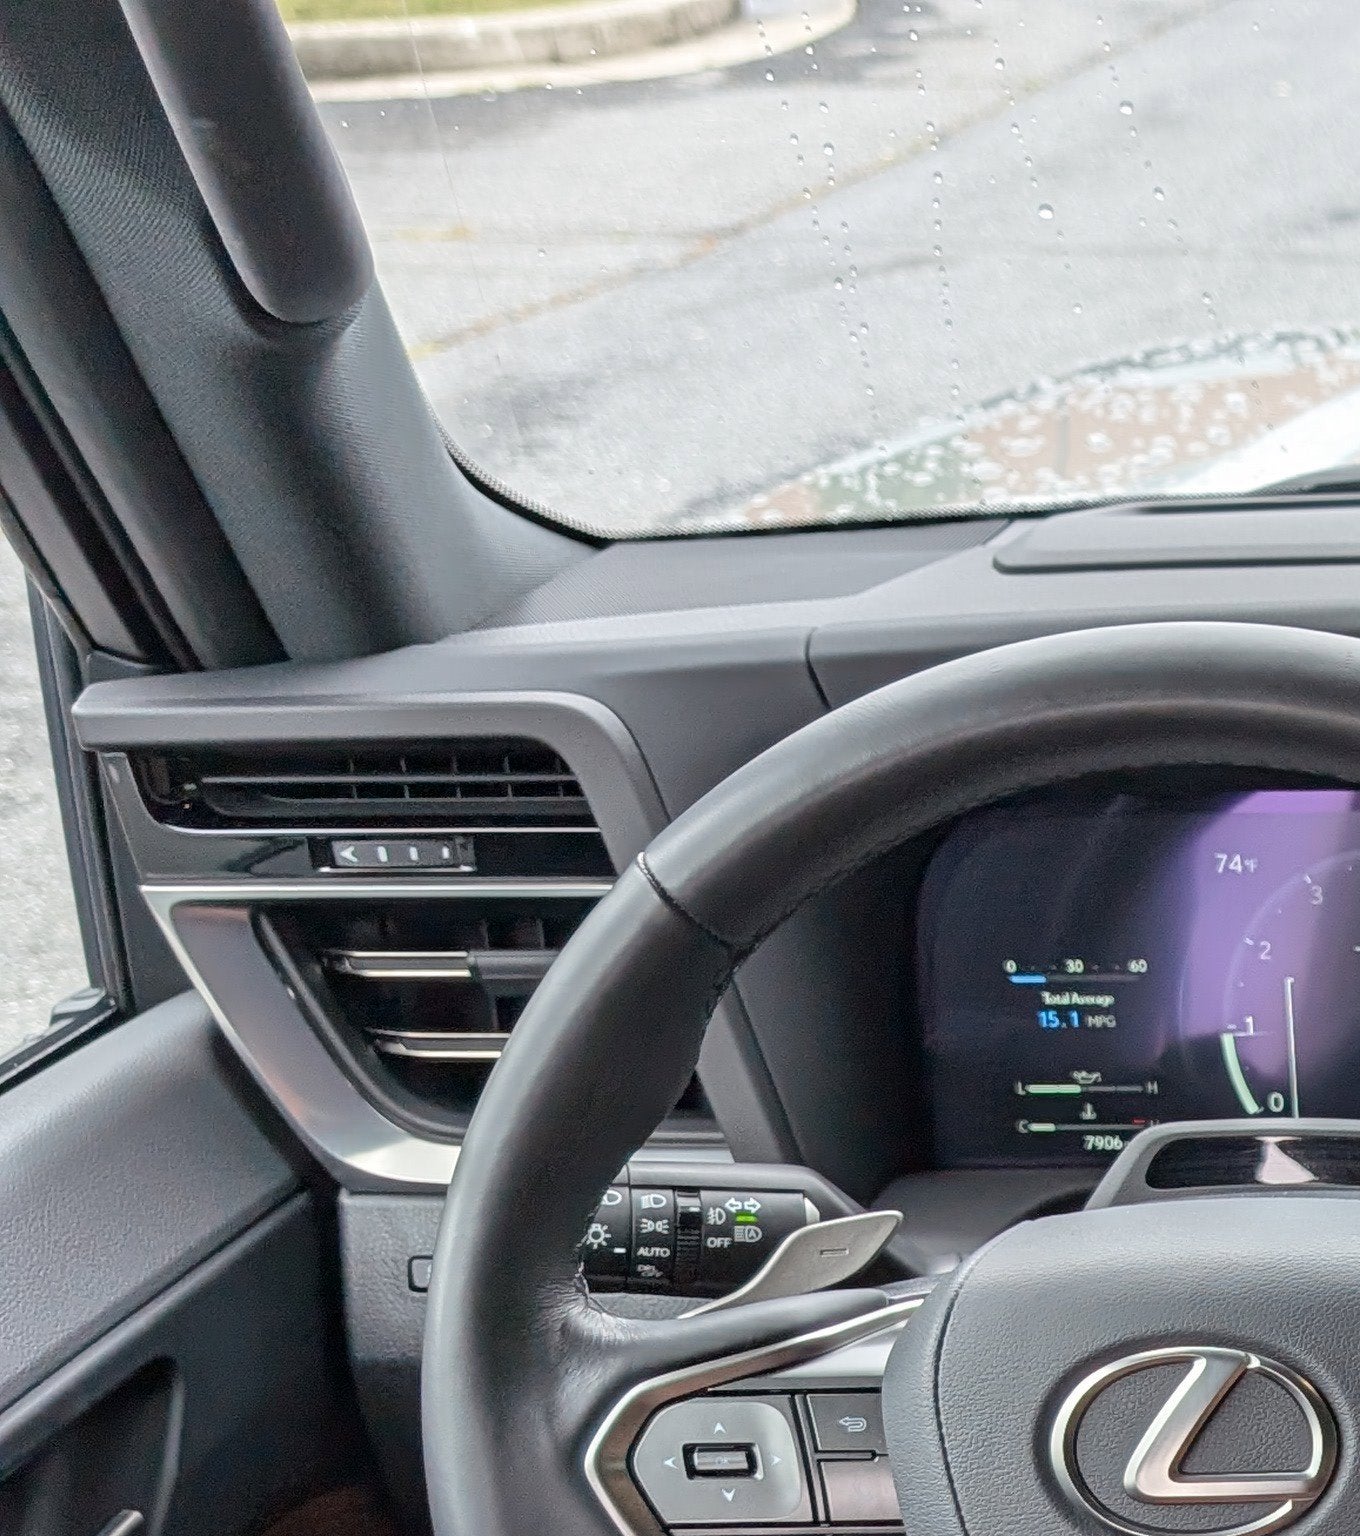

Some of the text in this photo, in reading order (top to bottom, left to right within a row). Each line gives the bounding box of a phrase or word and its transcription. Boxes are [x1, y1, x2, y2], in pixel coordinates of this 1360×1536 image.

[1310, 884, 1324, 906] 3
[1260, 939, 1273, 961] 2
[1064, 958, 1085, 974] 30
[1040, 991, 1070, 1006] Total
[1036, 1010, 1082, 1029] 15.1
[1083, 1134, 1123, 1151] 7906
[706, 1236, 733, 1249] OFF
[635, 1246, 671, 1259] AUTO
